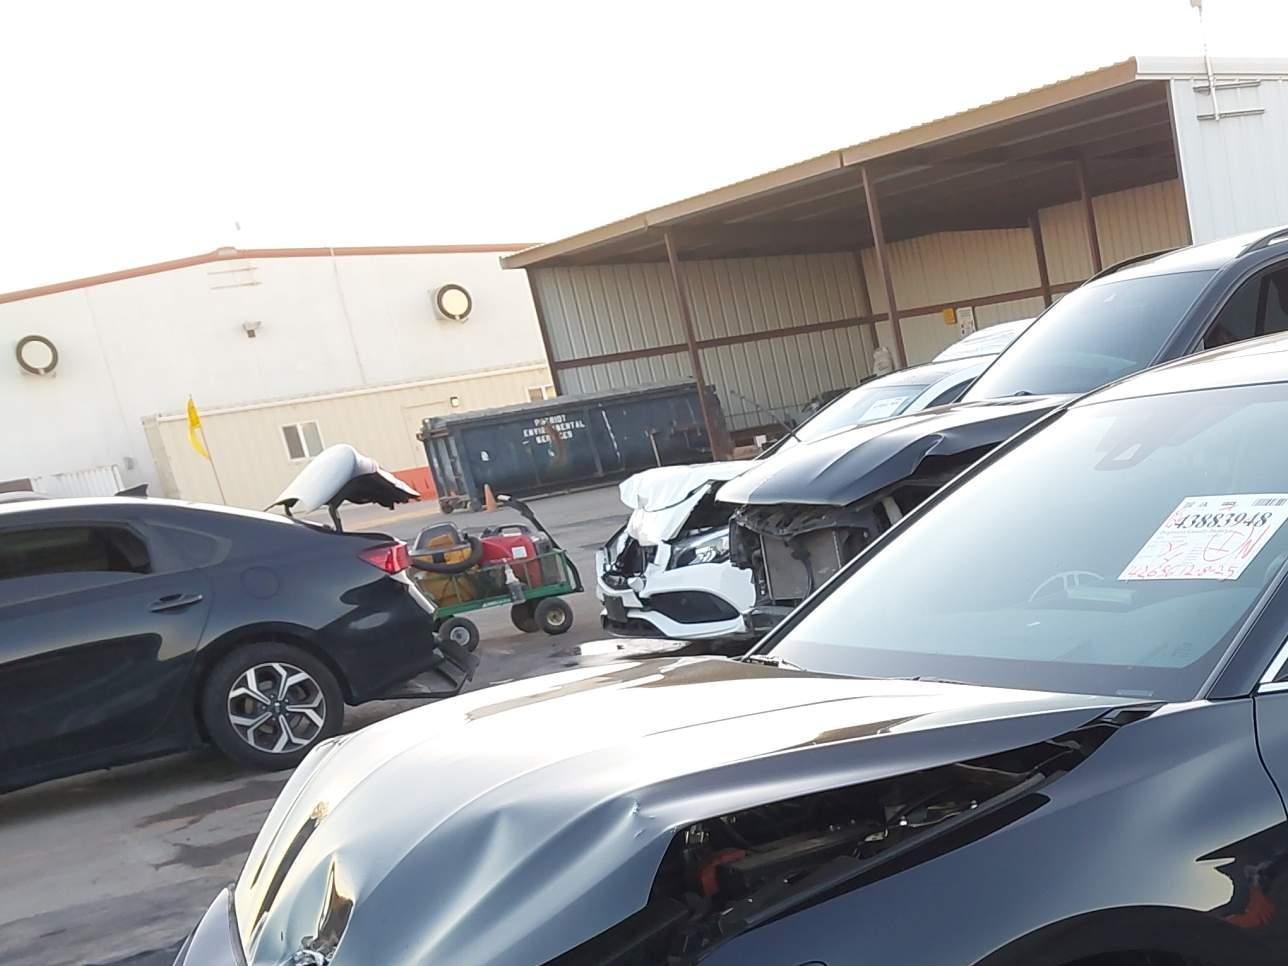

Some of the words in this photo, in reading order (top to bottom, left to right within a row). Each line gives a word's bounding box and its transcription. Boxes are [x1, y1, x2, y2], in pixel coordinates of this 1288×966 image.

[523, 420, 586, 437] ENVIRMENTAL
[535, 430, 573, 444] SERCES
[1174, 511, 1273, 529] 43883948
